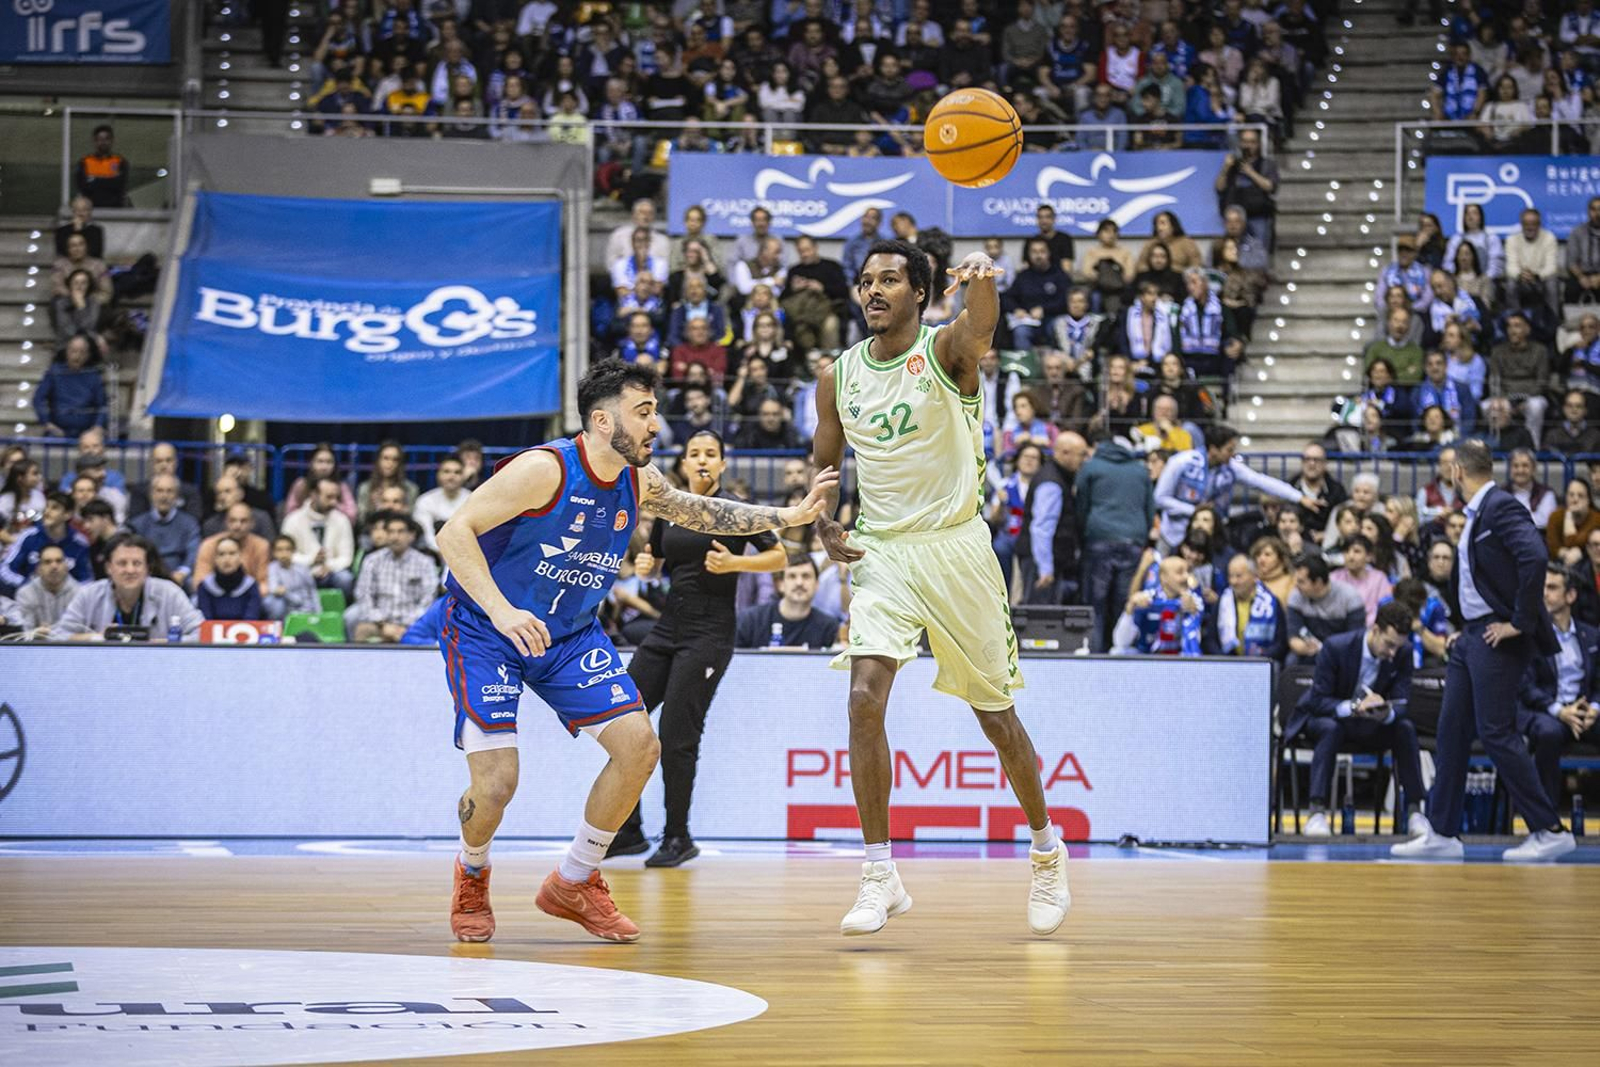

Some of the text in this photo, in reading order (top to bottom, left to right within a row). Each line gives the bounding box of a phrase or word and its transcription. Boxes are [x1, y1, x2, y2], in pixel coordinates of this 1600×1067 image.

[870, 402, 918, 442] 32
[534, 560, 605, 590] BURGOS
[548, 588, 566, 615] 1
[786, 749, 1093, 790] PMEA
[15, 1020, 587, 1032] Fundación
